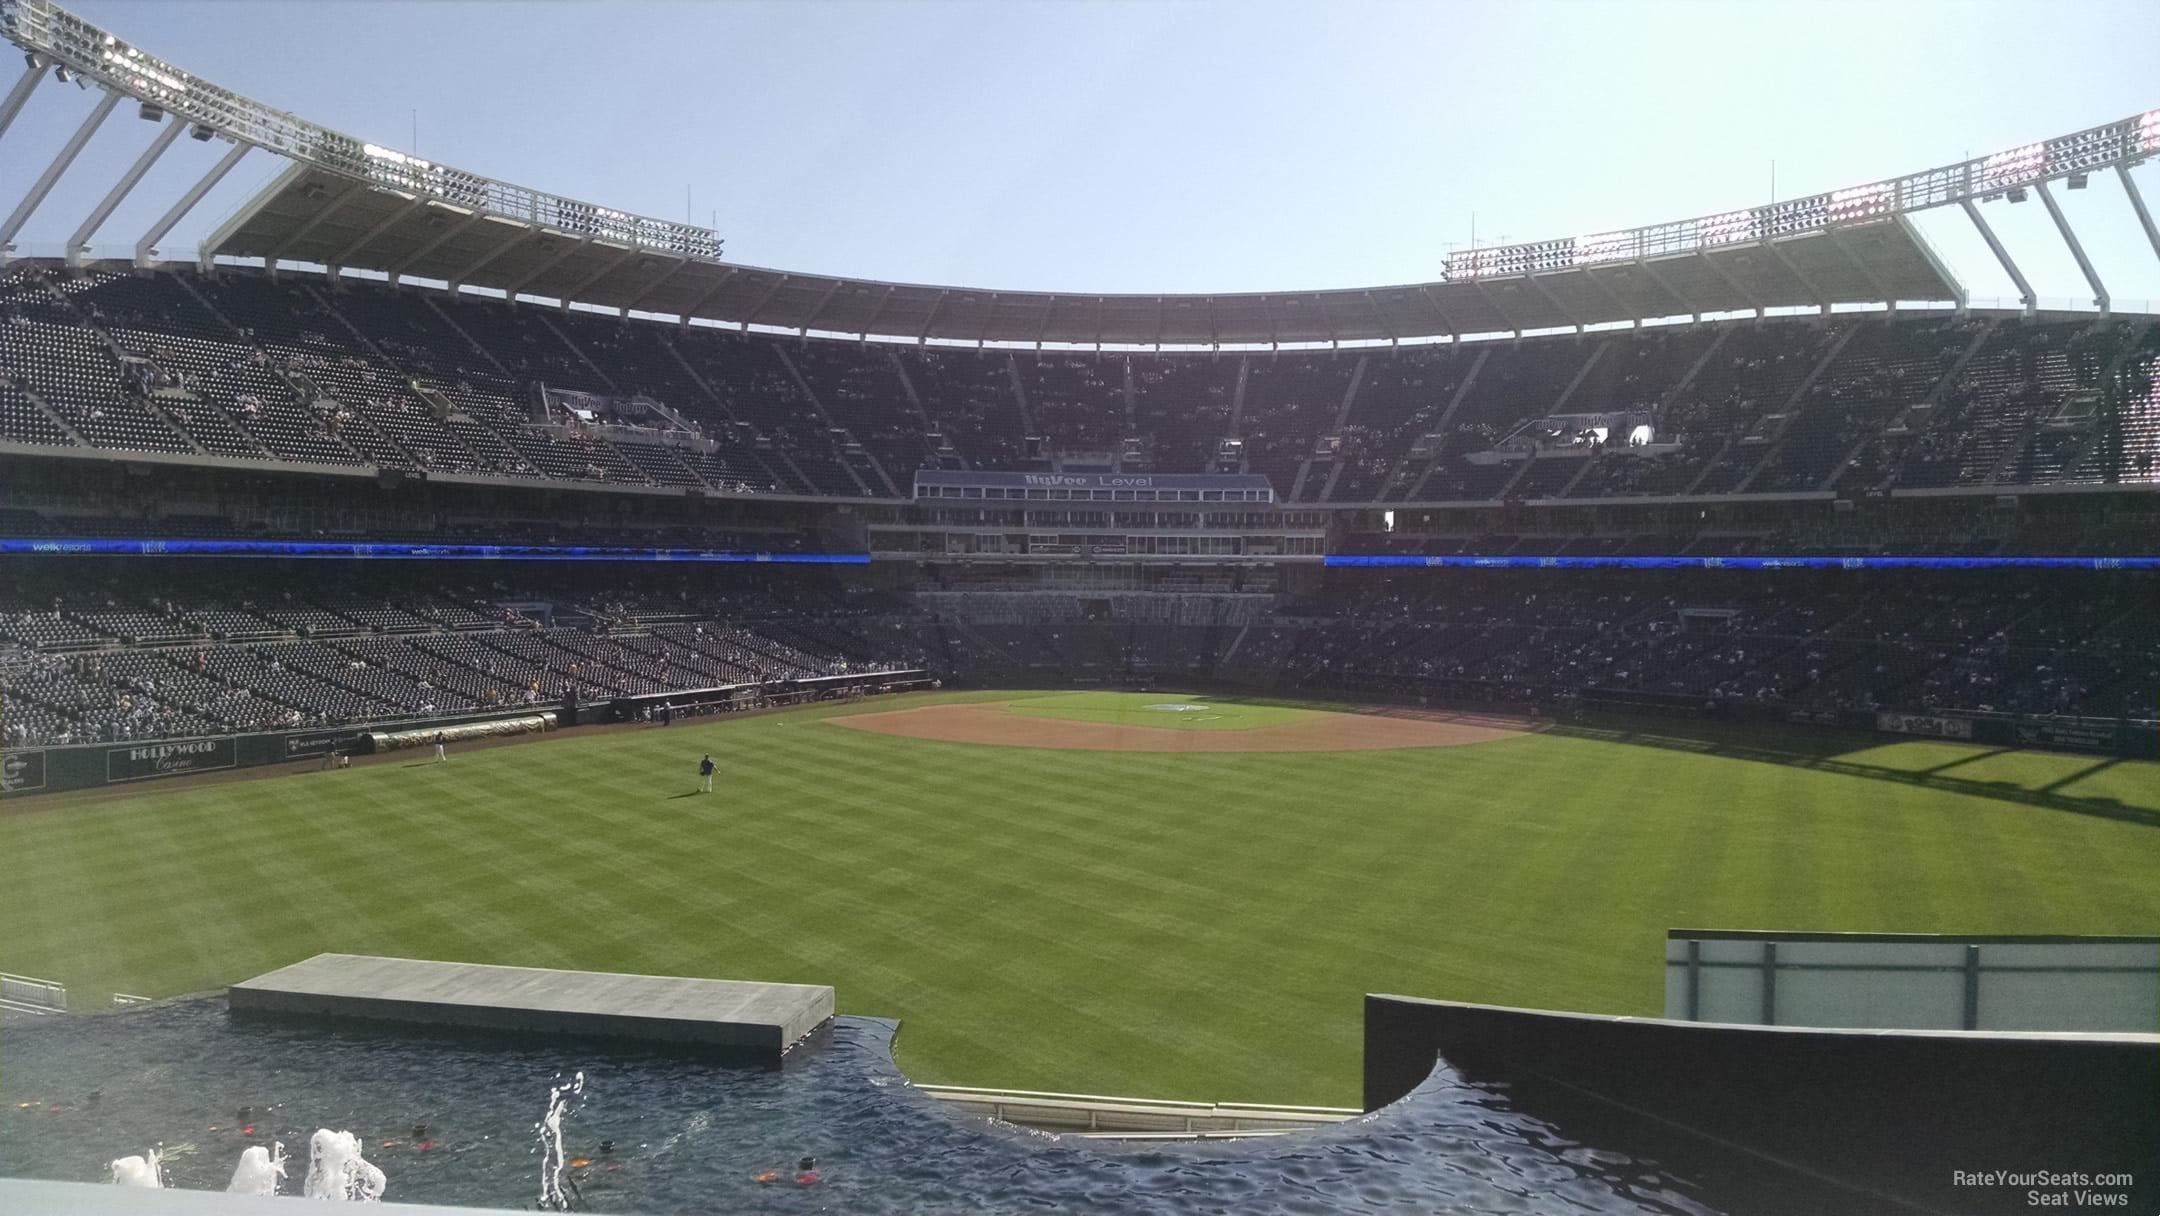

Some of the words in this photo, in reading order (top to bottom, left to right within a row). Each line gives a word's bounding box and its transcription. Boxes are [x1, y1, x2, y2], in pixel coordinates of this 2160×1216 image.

[1099, 476, 1153, 487] Level
[130, 741, 216, 761] HOLLYWOOD
[155, 757, 193, 770] Casino
